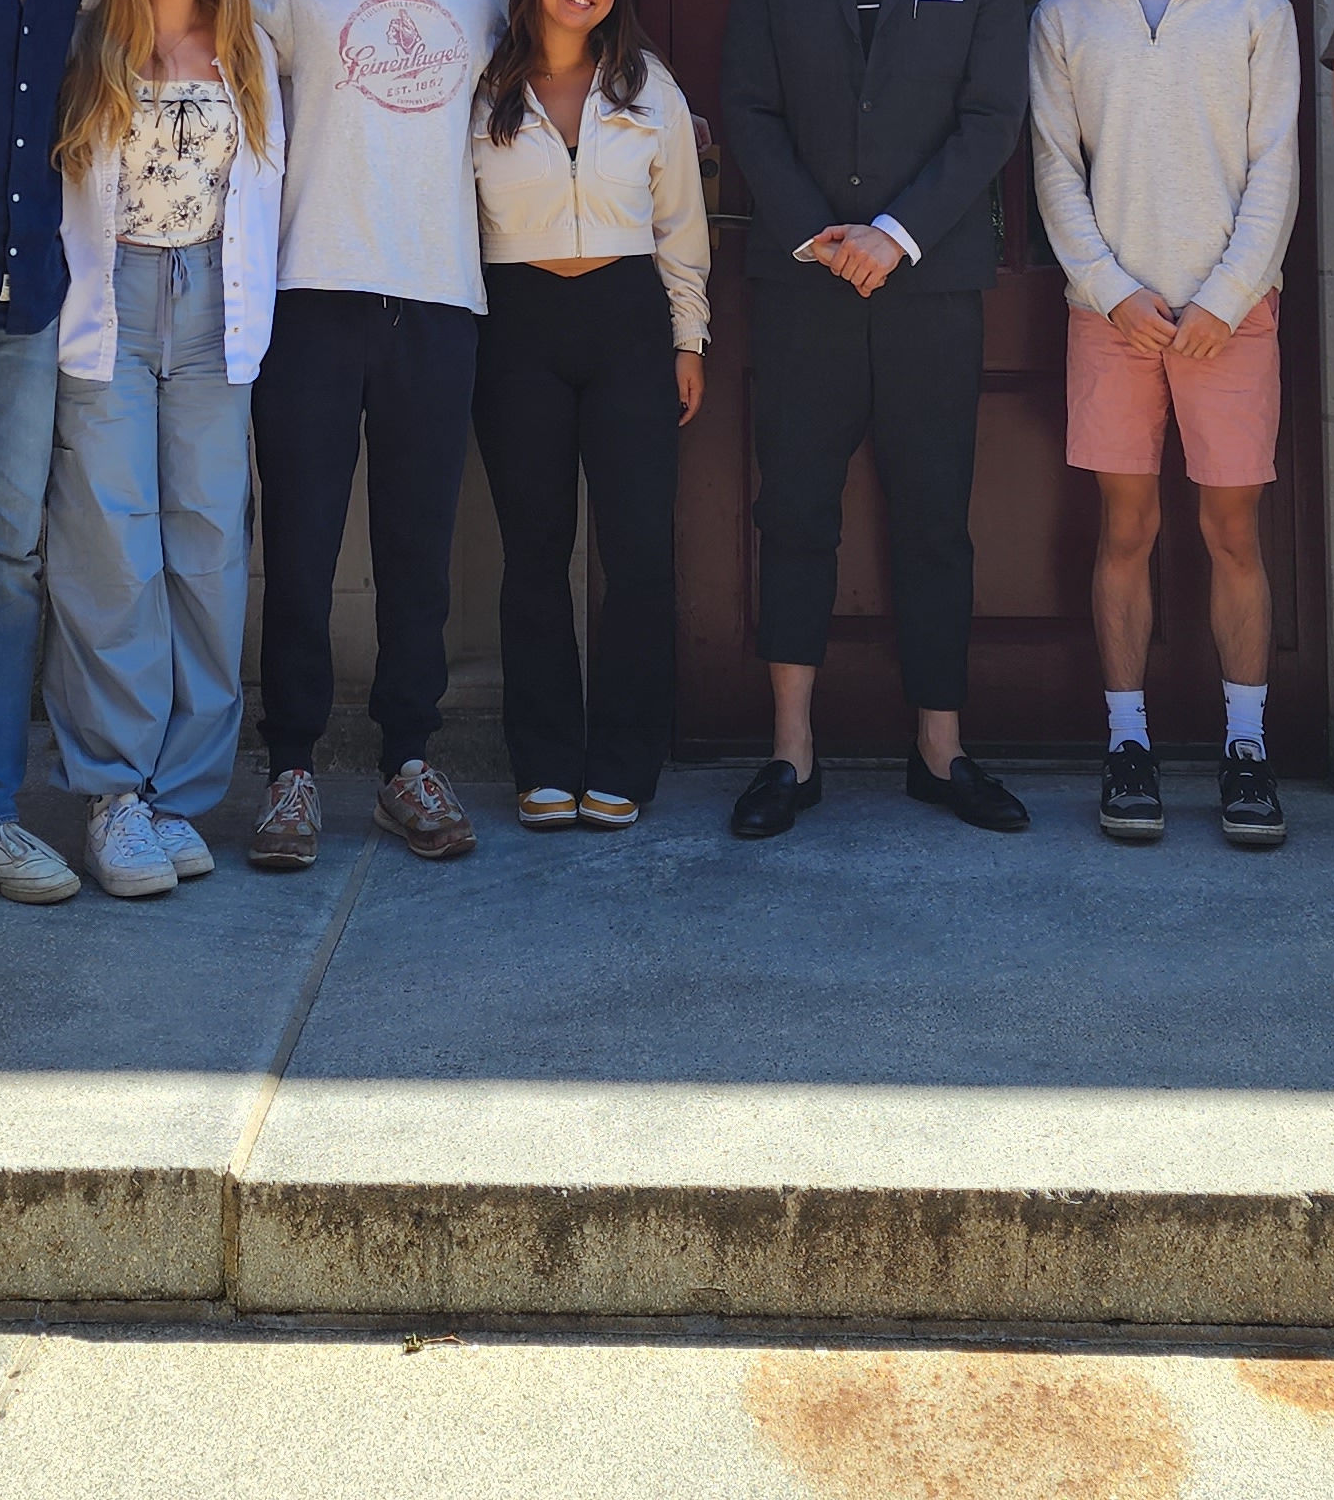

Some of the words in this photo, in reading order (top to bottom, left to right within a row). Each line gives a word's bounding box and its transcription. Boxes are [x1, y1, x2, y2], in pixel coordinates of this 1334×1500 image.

[335, 36, 469, 90] Leinenkugel's
[386, 86, 412, 98] EST.
[416, 77, 444, 92] 1867
